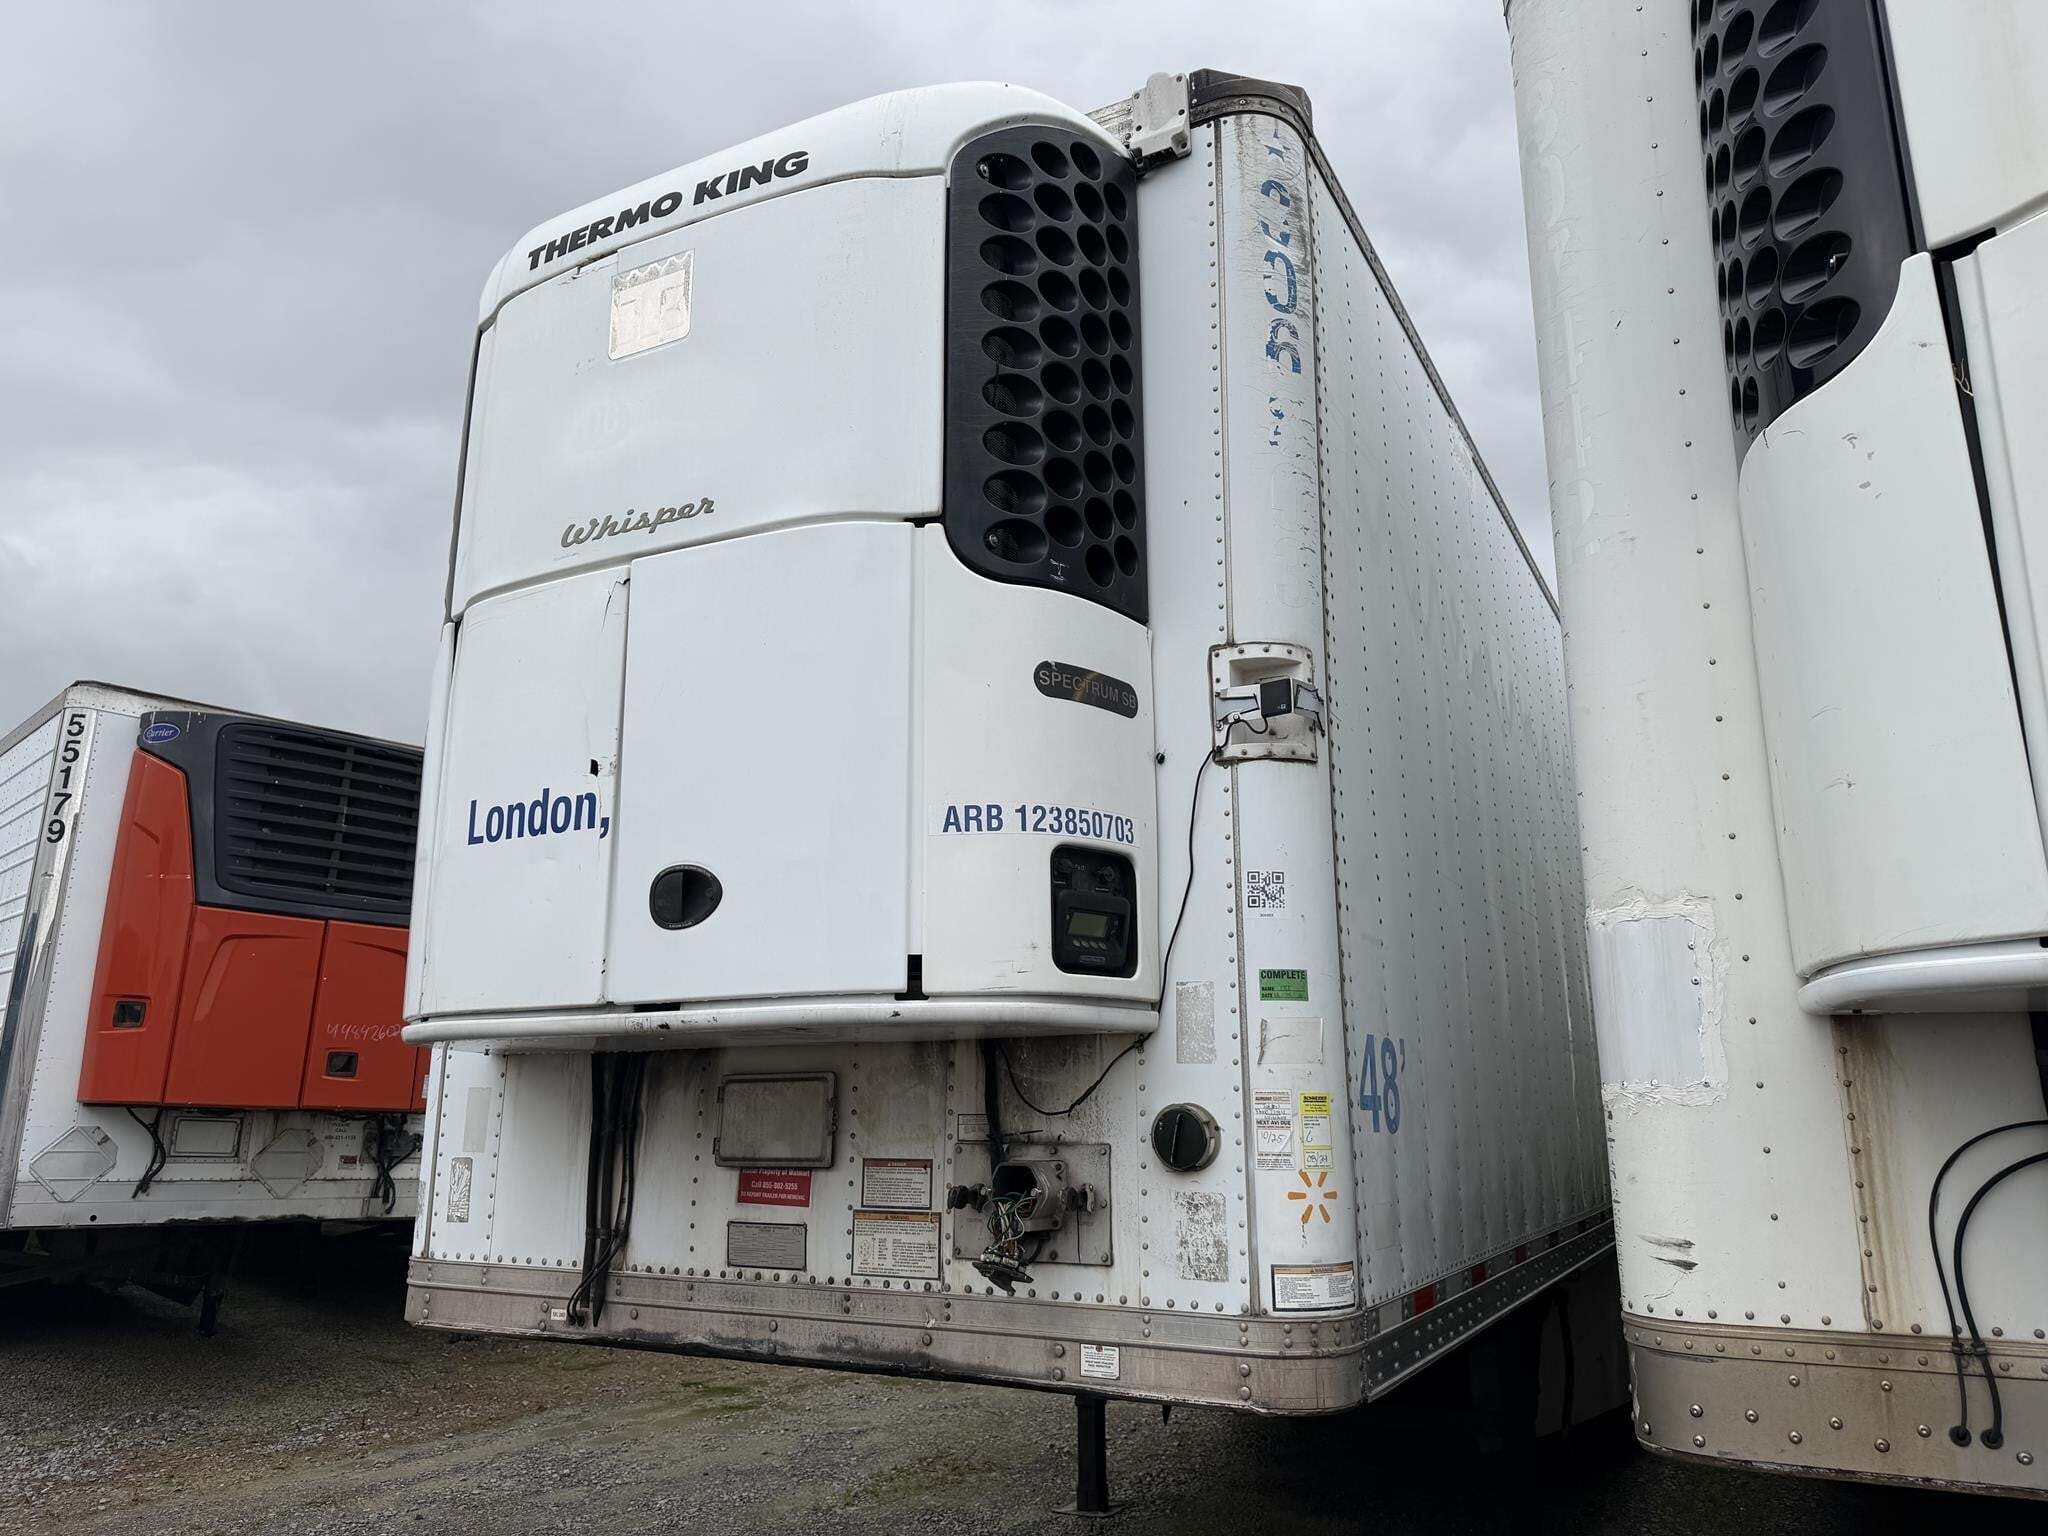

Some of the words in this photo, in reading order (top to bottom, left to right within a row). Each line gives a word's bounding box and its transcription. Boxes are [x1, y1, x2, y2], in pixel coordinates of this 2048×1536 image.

[527, 190, 683, 272] THERMO
[693, 150, 809, 206] KING
[560, 496, 715, 549] Whisper
[1038, 669, 1119, 703] SPECTRUM
[1120, 690, 1137, 709] SB
[467, 787, 610, 846] London,
[942, 804, 1004, 833] ARB
[1014, 804, 1135, 845] 123850703
[1260, 970, 1306, 980] COMPLETE
